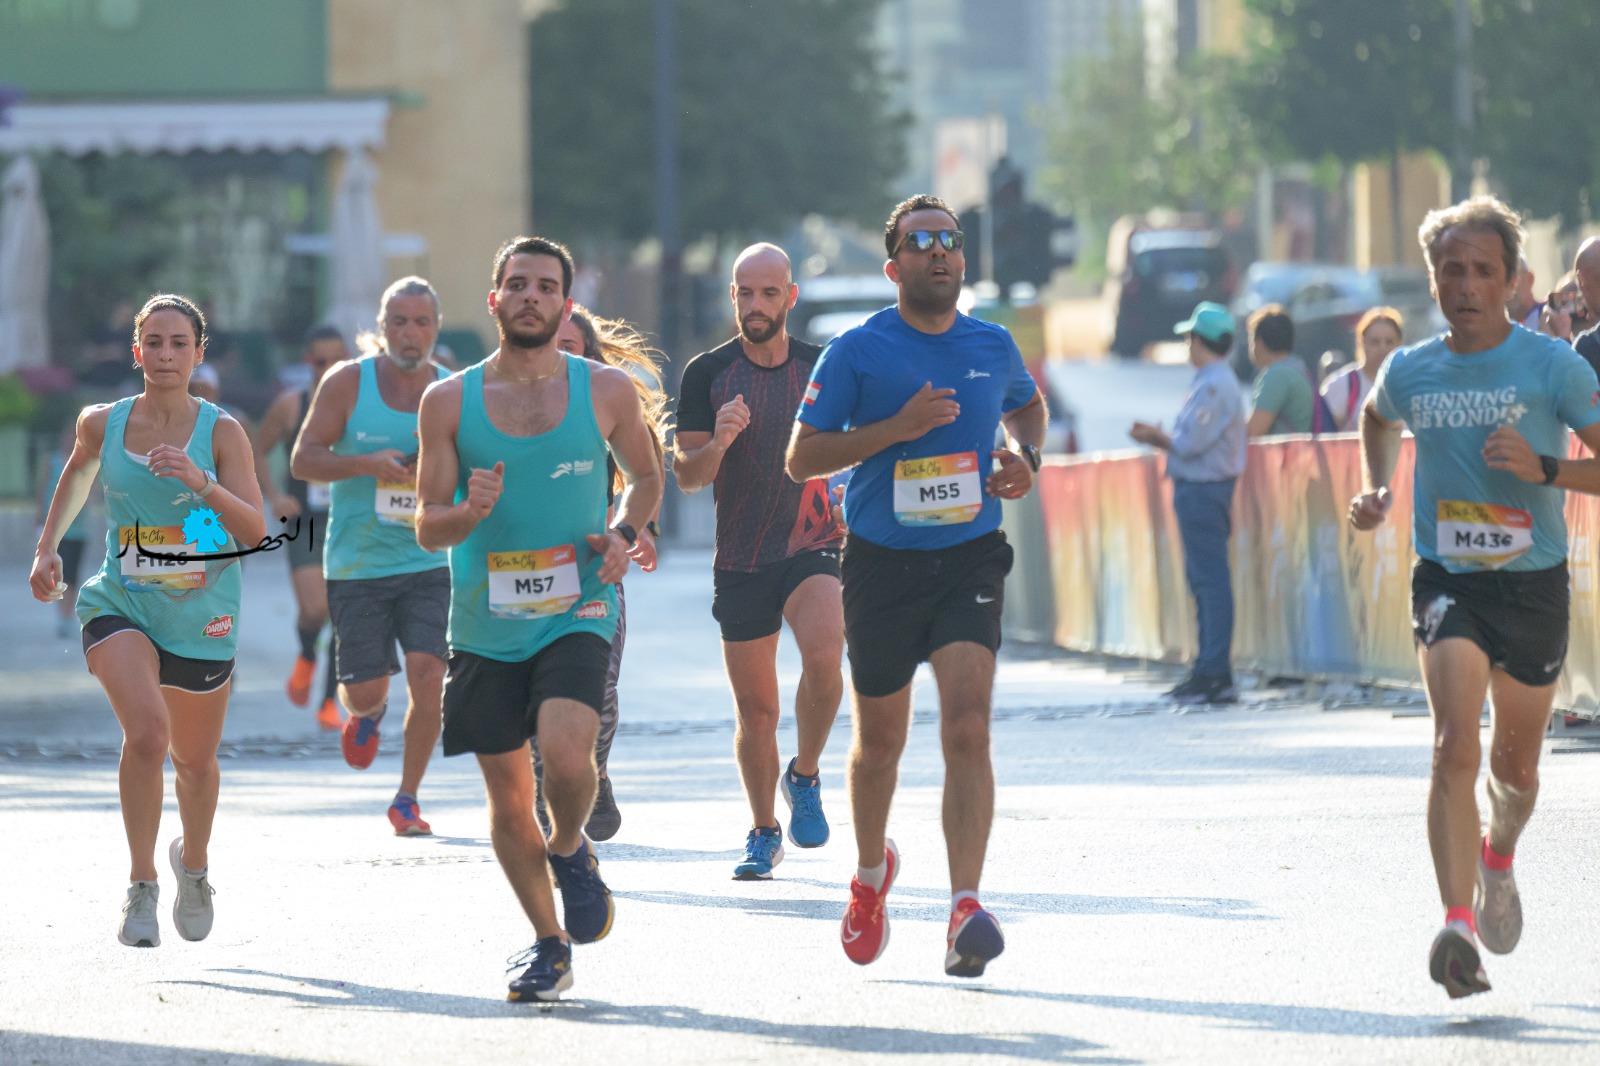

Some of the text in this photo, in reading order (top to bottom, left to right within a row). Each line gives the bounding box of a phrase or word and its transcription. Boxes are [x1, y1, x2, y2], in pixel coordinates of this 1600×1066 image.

[1411, 386, 1516, 411] RUNNING
[920, 482, 960, 502] M55
[149, 528, 165, 544] City
[1456, 529, 1513, 548] M436
[515, 576, 554, 594] M57
